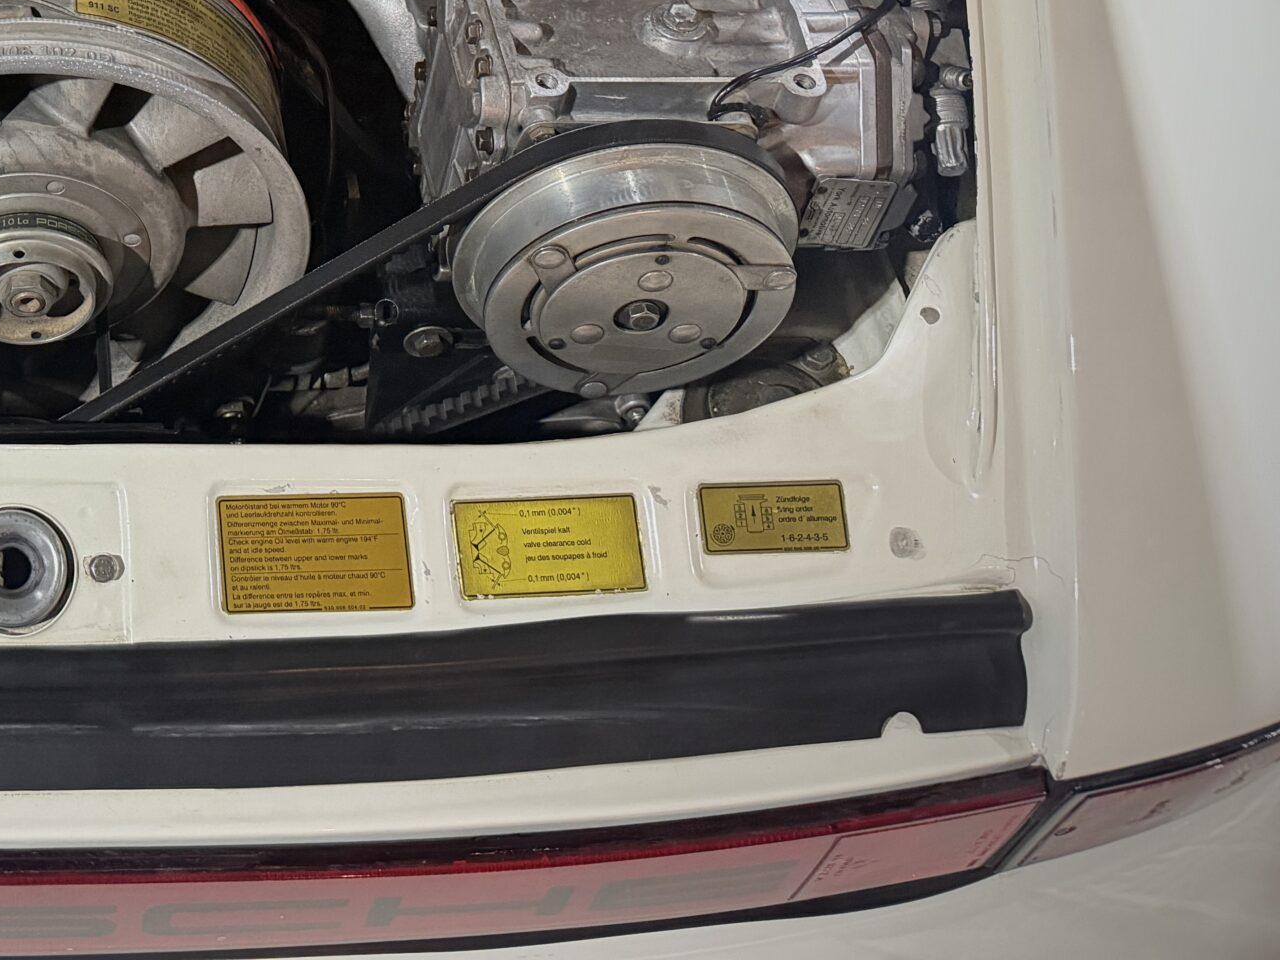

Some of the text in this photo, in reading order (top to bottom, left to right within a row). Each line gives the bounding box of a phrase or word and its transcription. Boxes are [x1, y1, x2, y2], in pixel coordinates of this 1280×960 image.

[88, 0, 120, 14] 911 SC
[522, 526, 570, 536] Ventilspiel kalt
[336, 536, 358, 544] engine
[781, 533, 829, 542] 1-6-2-4-3-5
[524, 540, 541, 548] valve
[525, 553, 536, 563] jeu
[537, 552, 550, 560] des
[551, 553, 585, 562] soupapes
[592, 551, 608, 559] froid
[294, 600, 309, 608] 1,75
